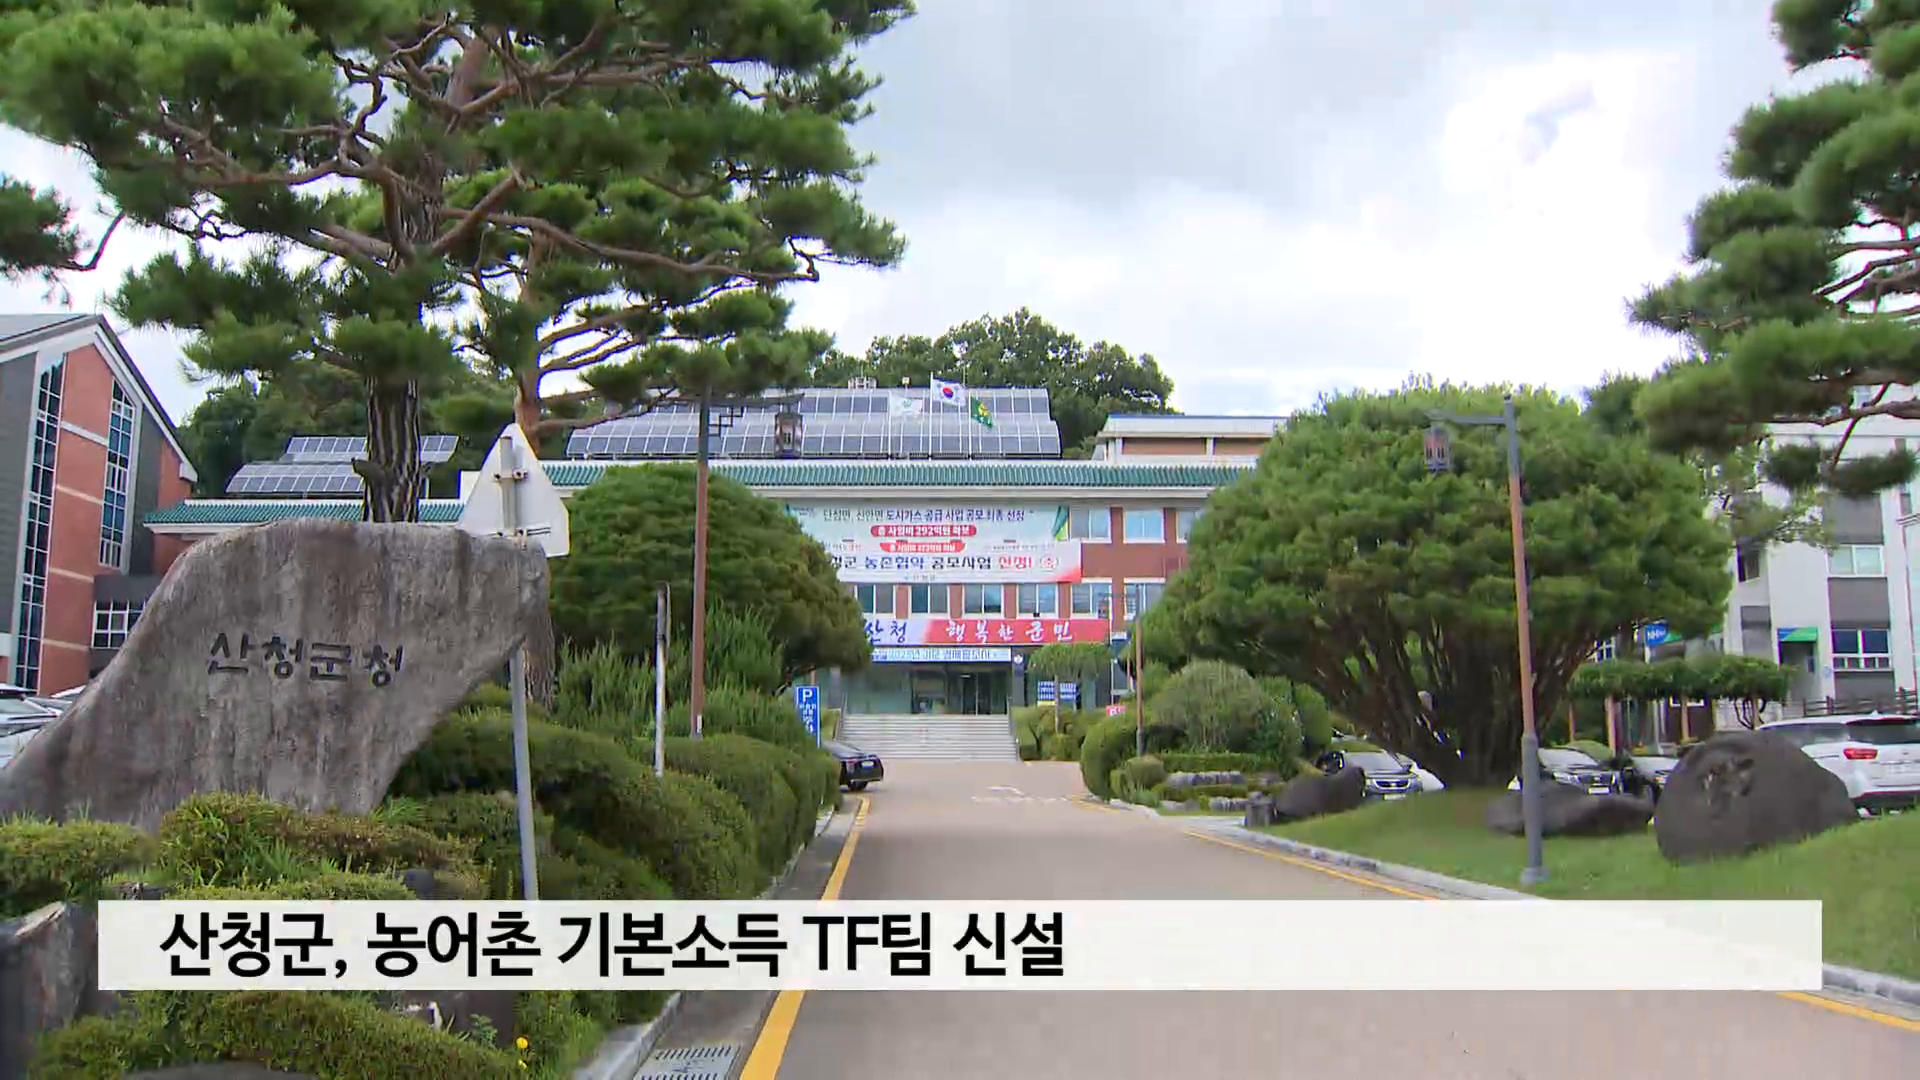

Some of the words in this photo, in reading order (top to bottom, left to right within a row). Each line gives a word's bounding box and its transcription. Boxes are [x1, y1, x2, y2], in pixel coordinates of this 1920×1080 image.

[886, 508, 922, 522] 도시가스
[864, 555, 925, 570] 농촌협약
[931, 555, 991, 570] 공모사업
[946, 619, 1014, 644] 행복한
[1025, 620, 1073, 642] 군민
[207, 632, 404, 688] 산청군청
[802, 689, 814, 702] P
